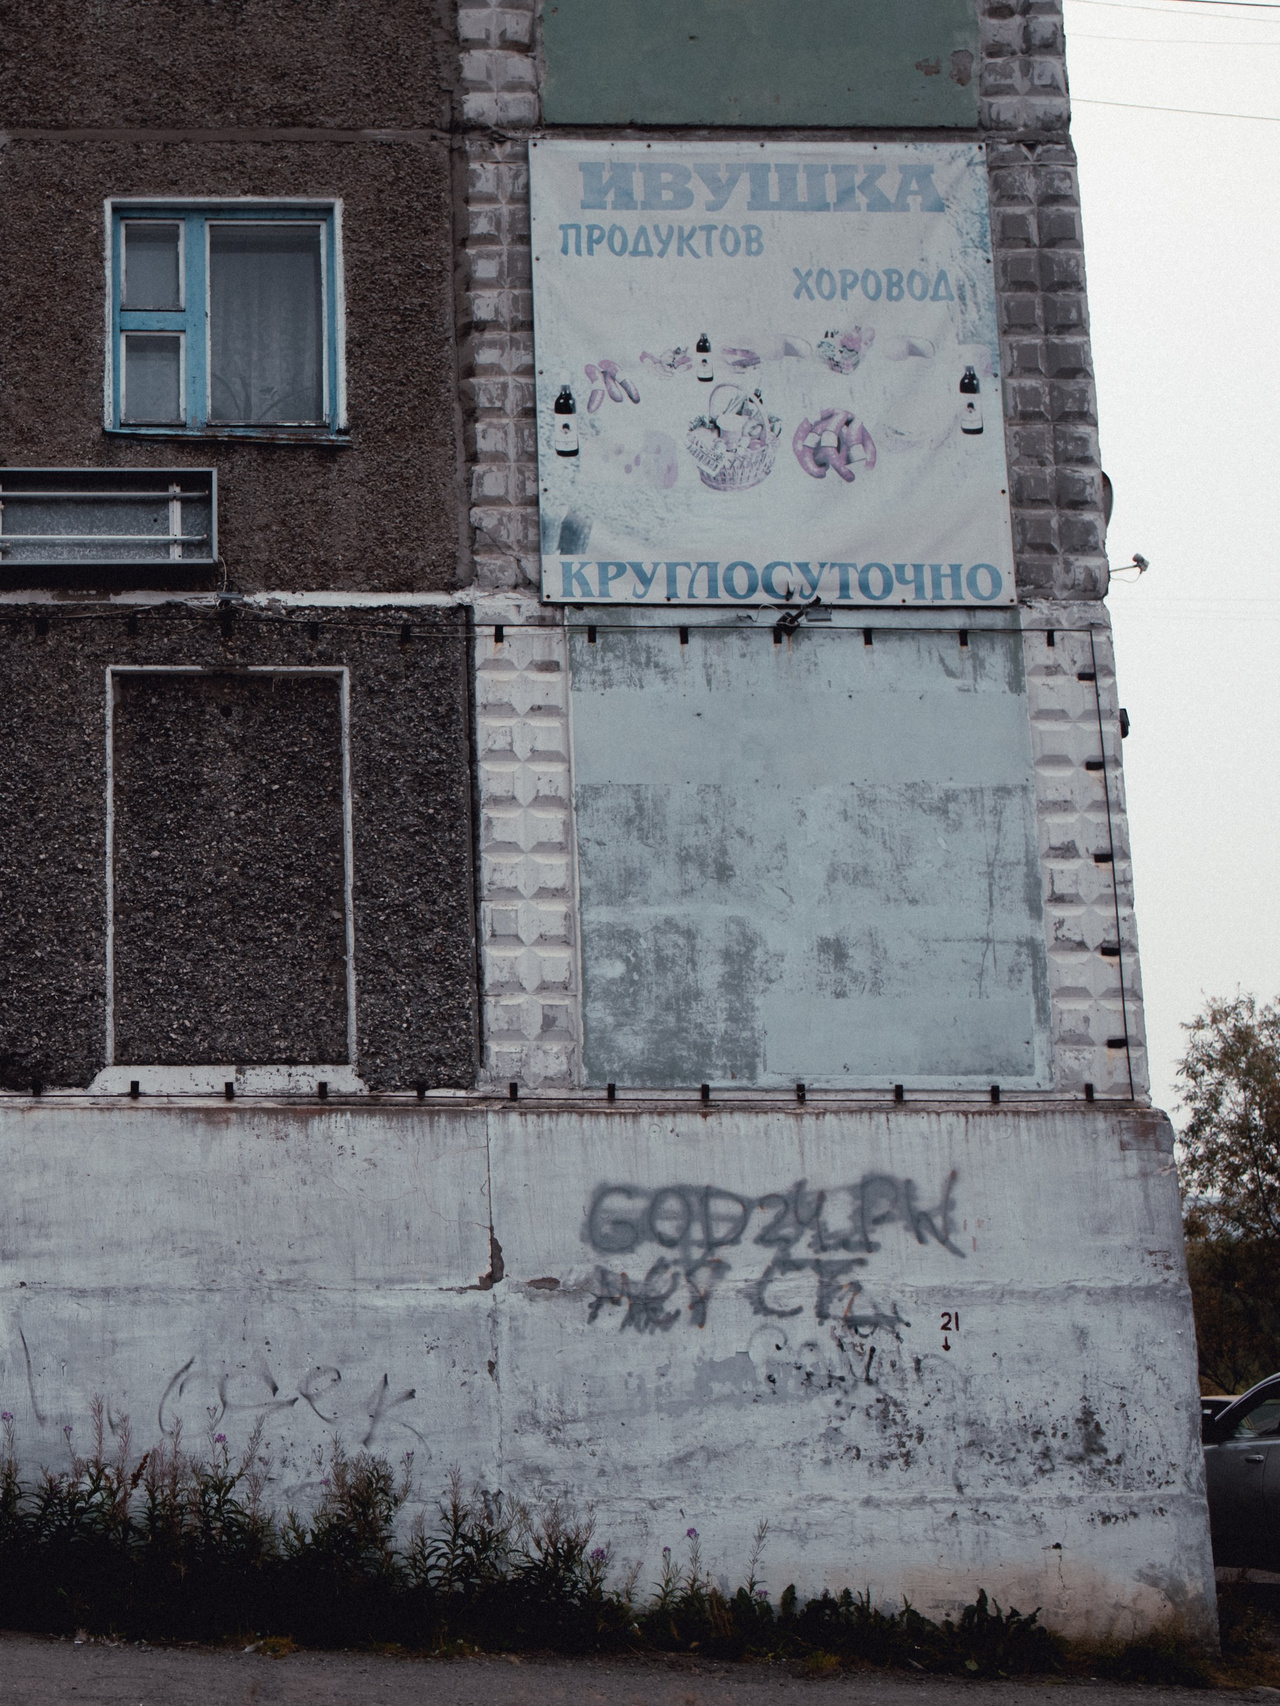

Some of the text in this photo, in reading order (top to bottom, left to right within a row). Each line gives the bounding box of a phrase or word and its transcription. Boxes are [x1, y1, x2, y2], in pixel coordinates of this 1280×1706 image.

[578, 161, 946, 213] ИВУШКА
[558, 222, 765, 259] ПРОДУКТОВ
[792, 267, 956, 302] ХОРОВОД
[559, 560, 1004, 601] КРУГЛОСУТОЧНО
[940, 1311, 960, 1332] 21
